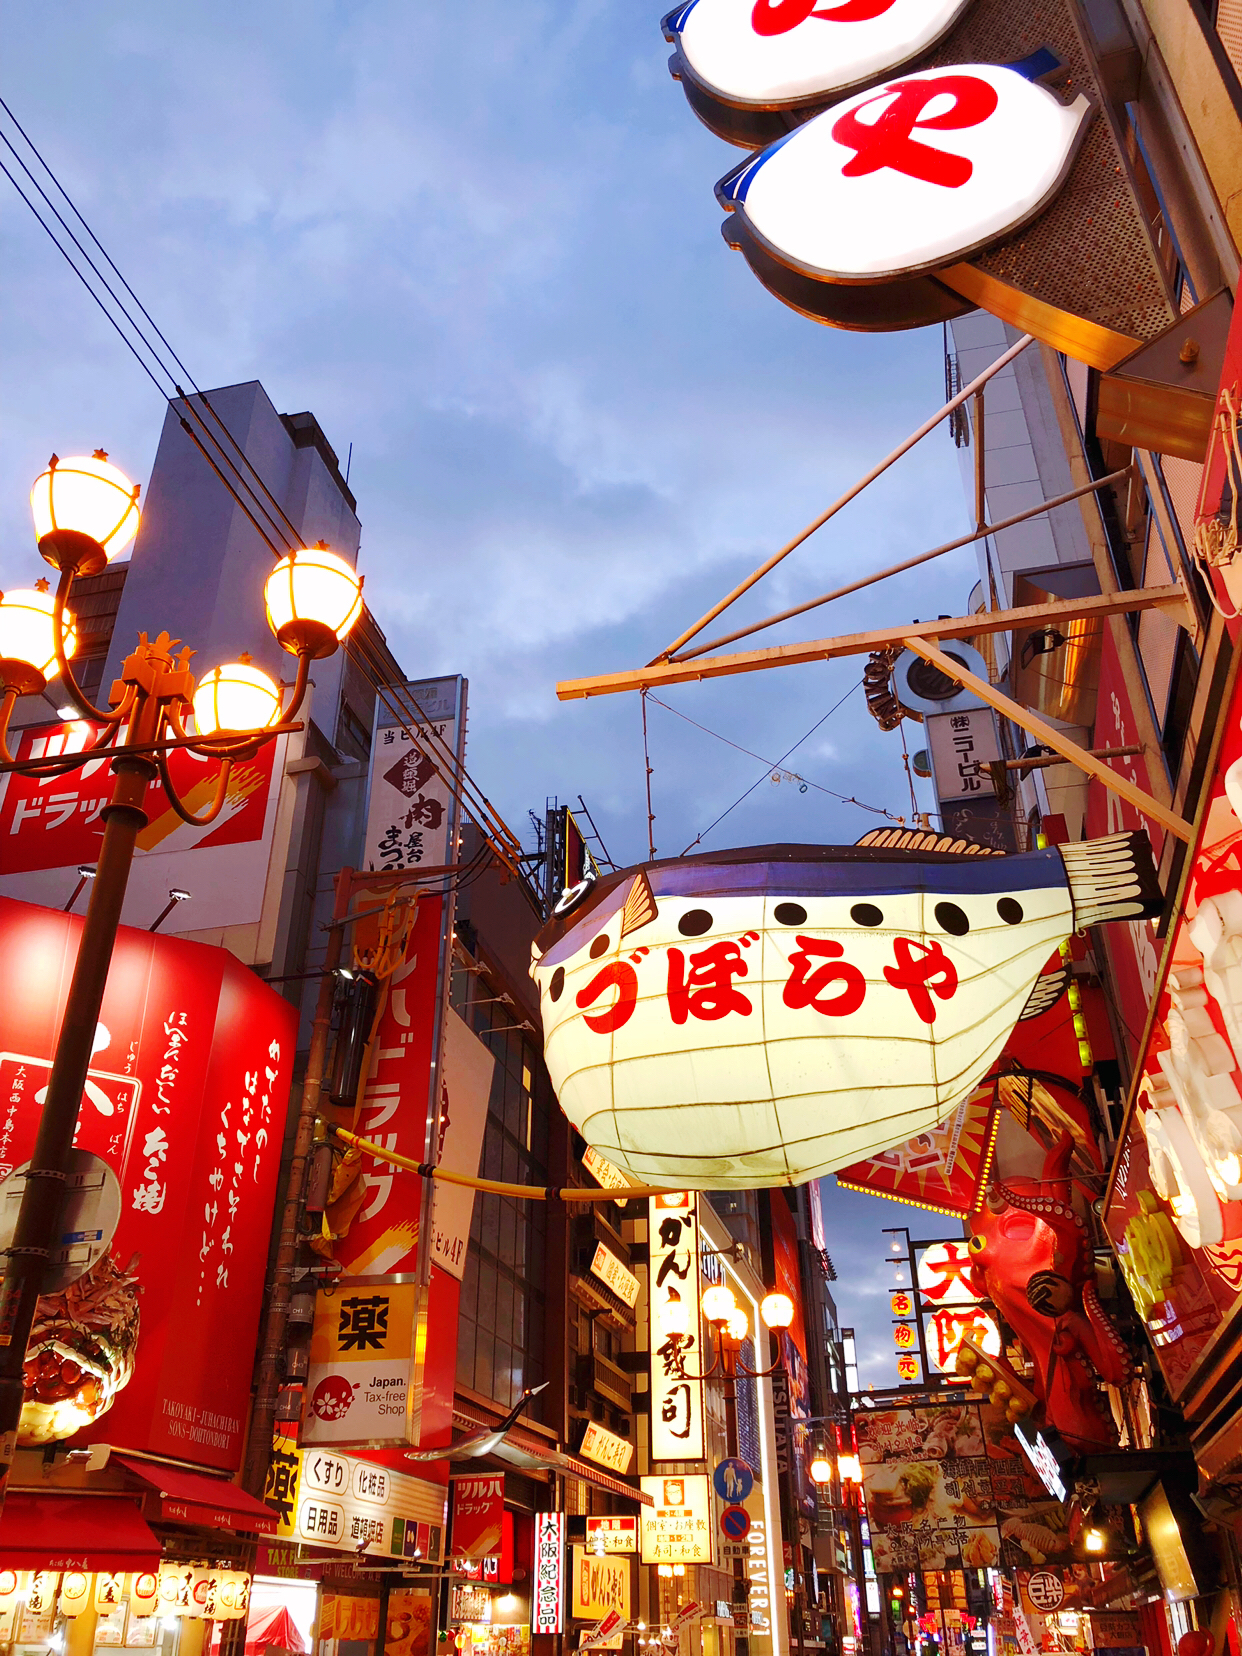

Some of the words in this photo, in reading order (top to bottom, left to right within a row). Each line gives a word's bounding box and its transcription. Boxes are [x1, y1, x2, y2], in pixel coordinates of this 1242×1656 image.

[831, 75, 998, 188] や
[10, 779, 162, 836] ドラッ
[399, 794, 446, 830] 肉
[404, 832, 424, 863] 屋台
[117, 1092, 128, 1113] はち
[107, 1134, 123, 1155] ばん
[434, 1232, 464, 1266] ビル4F
[338, 1296, 390, 1351] 薬
[369, 1376, 406, 1389] Japan.
[364, 1391, 406, 1404] Tax-free
[378, 1404, 405, 1417] Shop
[311, 1454, 344, 1491] くすり
[358, 1470, 386, 1498] 化粧品
[457, 1481, 502, 1499] ツルハ
[306, 1506, 339, 1536] 日用品
[457, 1502, 493, 1515] ドラッグ
[267, 1549, 288, 1565] TAX
[289, 1549, 310, 1565] FEE
[747, 1520, 769, 1609] FOREVER
[277, 1566, 299, 1578] STORE
